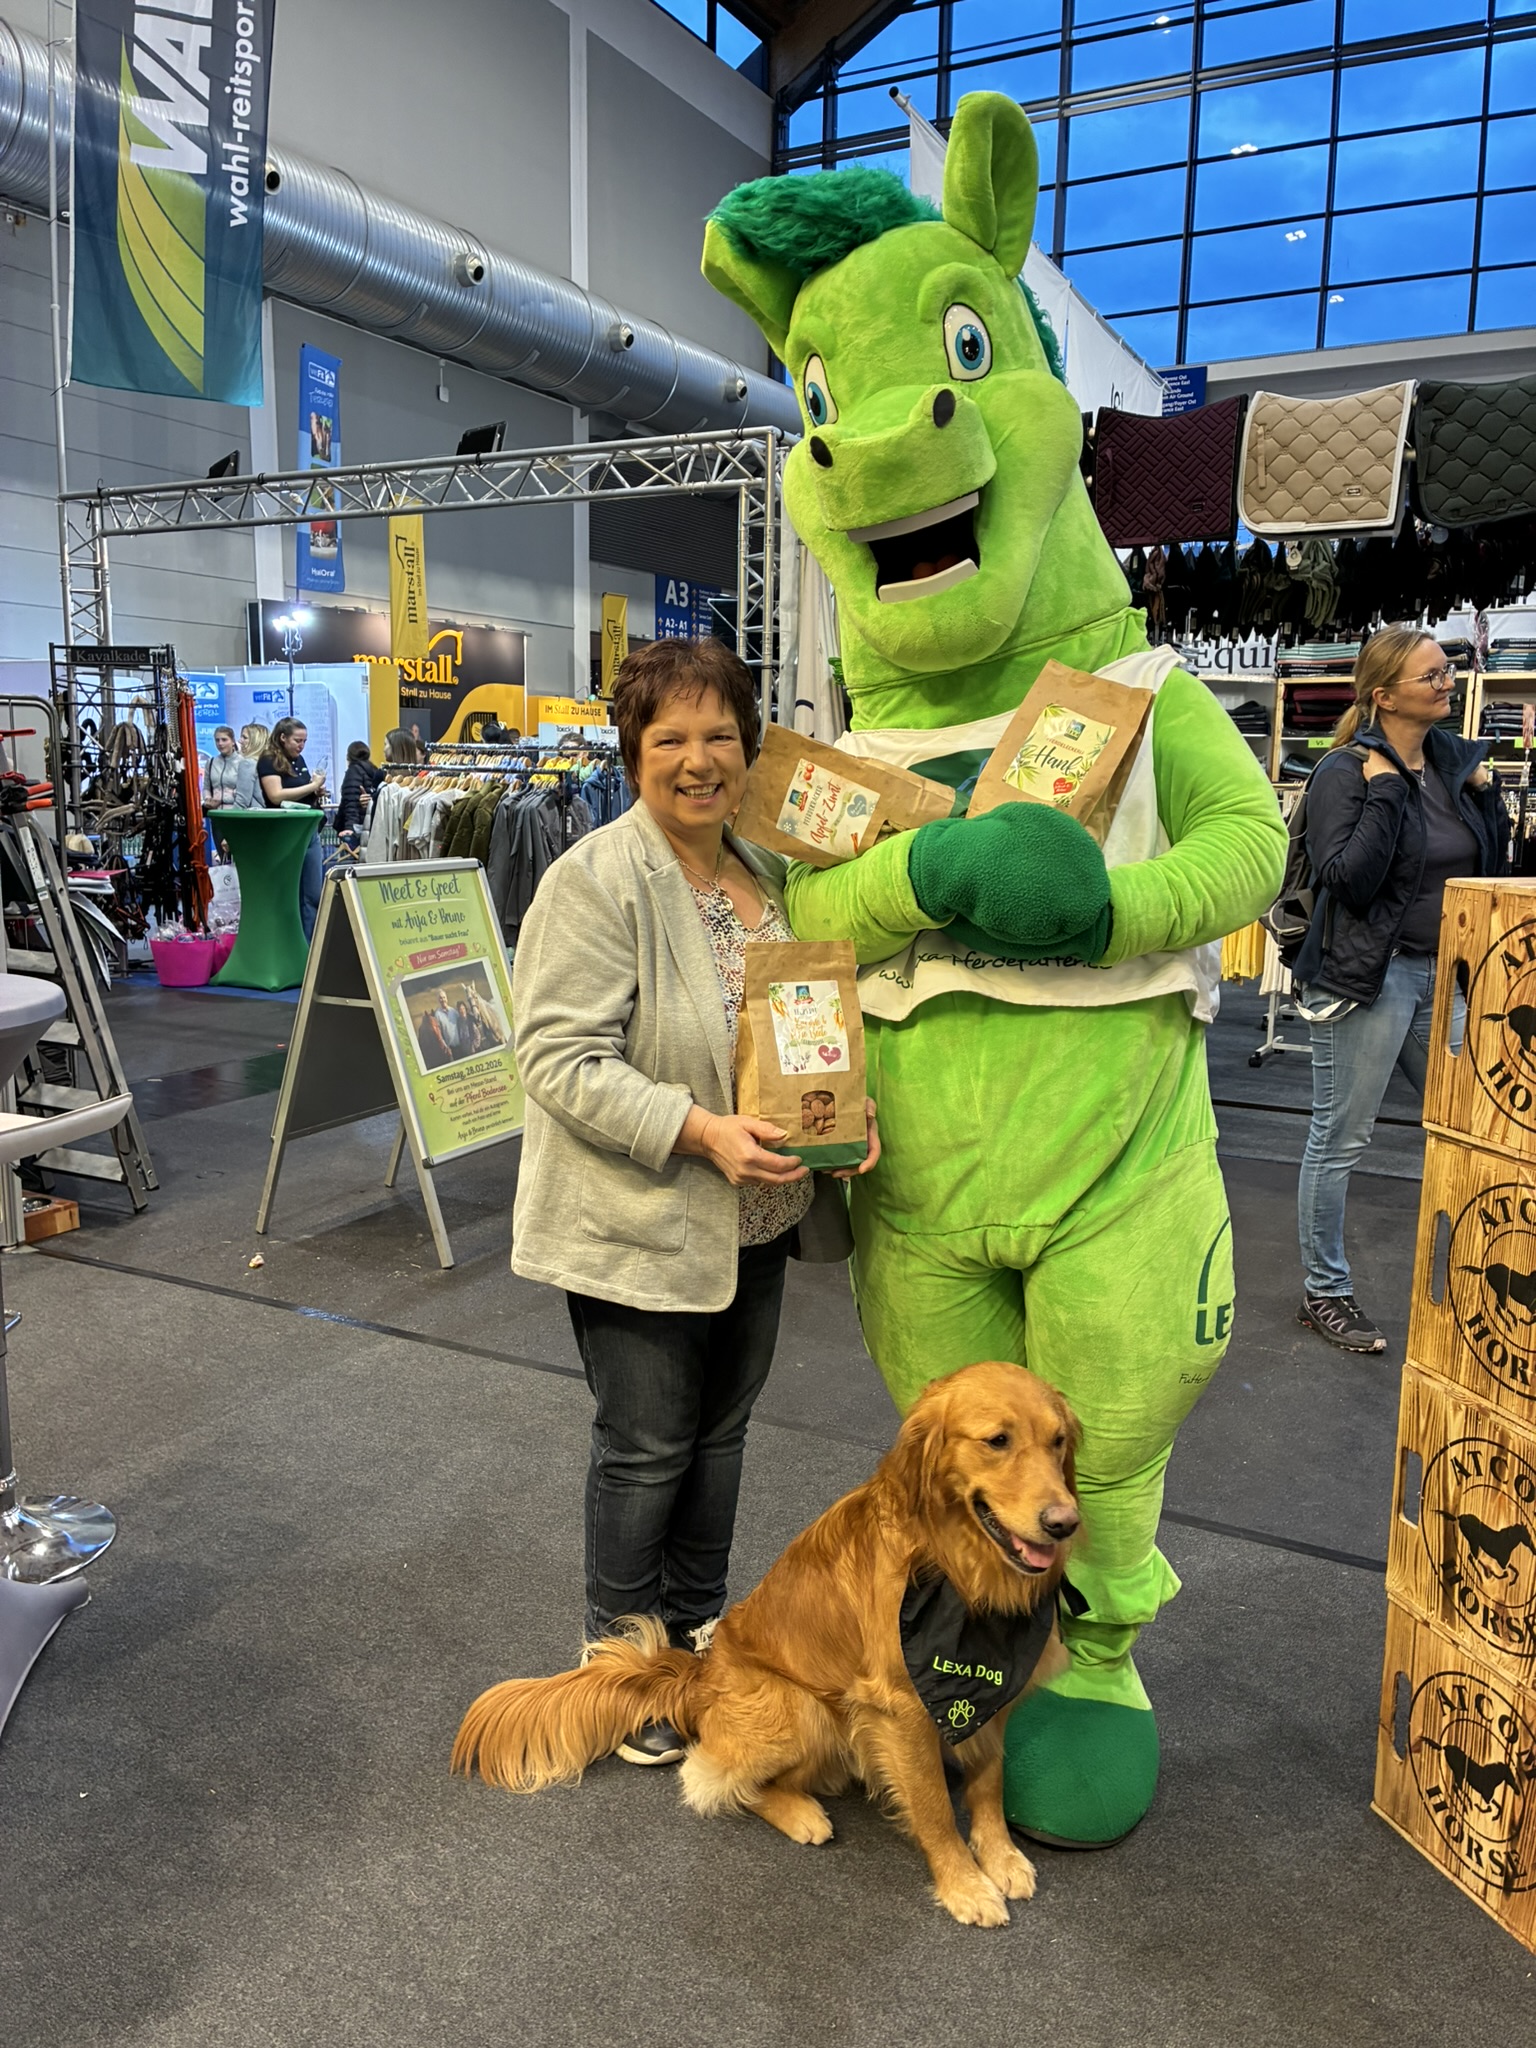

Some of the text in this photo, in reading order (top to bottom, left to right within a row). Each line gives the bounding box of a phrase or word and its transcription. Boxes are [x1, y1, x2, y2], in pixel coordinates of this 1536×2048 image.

[221, 0, 262, 228] wahl-reitspor
[404, 546, 418, 624] marstall
[664, 580, 689, 608] A3
[678, 620, 688, 630] A1
[76, 649, 146, 662] Kavalkade
[400, 686, 452, 700] Stall zu Hause
[544, 704, 554, 714] IM
[570, 706, 580, 715] ZU
[580, 706, 602, 717] HAUSE
[1033, 744, 1084, 776] Hanf
[810, 778, 842, 845] Apfel-Zimt
[378, 873, 461, 904] Meet & Greet
[392, 908, 465, 933] mit Anja & Bruno
[399, 936, 419, 946] bekannt
[416, 954, 427, 965] Nur
[436, 1059, 502, 1085] Samstag, 28.02.2026
[1486, 1057, 1533, 1113] HO
[465, 1090, 481, 1104] Pferd
[481, 1085, 507, 1098] Bodensee
[1478, 1195, 1536, 1237] ATC
[1195, 1302, 1232, 1345] LE
[1466, 1311, 1531, 1387] HOR
[1450, 1450, 1536, 1504] ATCO
[933, 1655, 1003, 1686] LEXA Dog
[1426, 1784, 1528, 1880] HORSE
